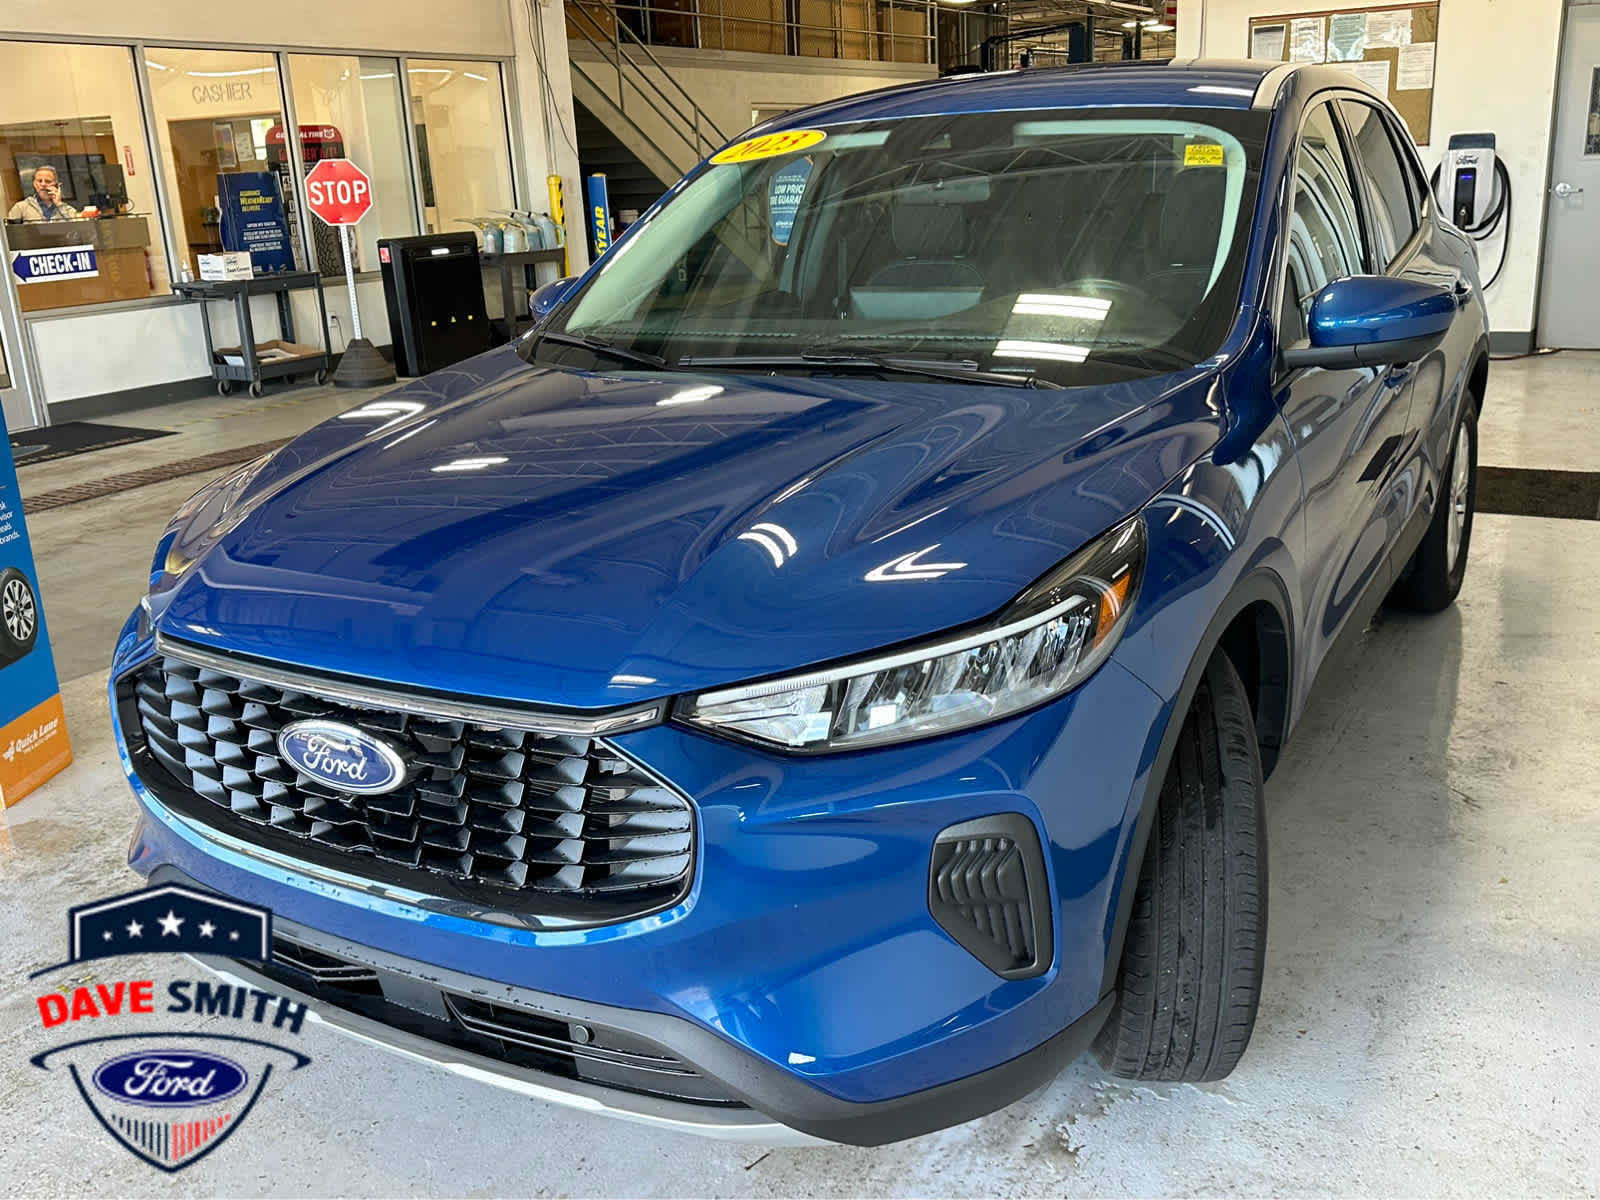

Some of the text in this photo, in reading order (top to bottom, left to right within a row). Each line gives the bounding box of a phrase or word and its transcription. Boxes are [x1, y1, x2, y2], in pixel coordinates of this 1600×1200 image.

[191, 81, 253, 105] CASHIER
[1455, 154, 1480, 166] Ford
[309, 179, 368, 206] STOP
[775, 184, 805, 194] LOW PRIC
[778, 195, 802, 205] GUARA
[29, 251, 92, 276] CHECK-IN
[0, 511, 13, 522] visor
[0, 521, 12, 533] eals
[15, 717, 59, 753] Quick Lane
[303, 735, 368, 781] Ford
